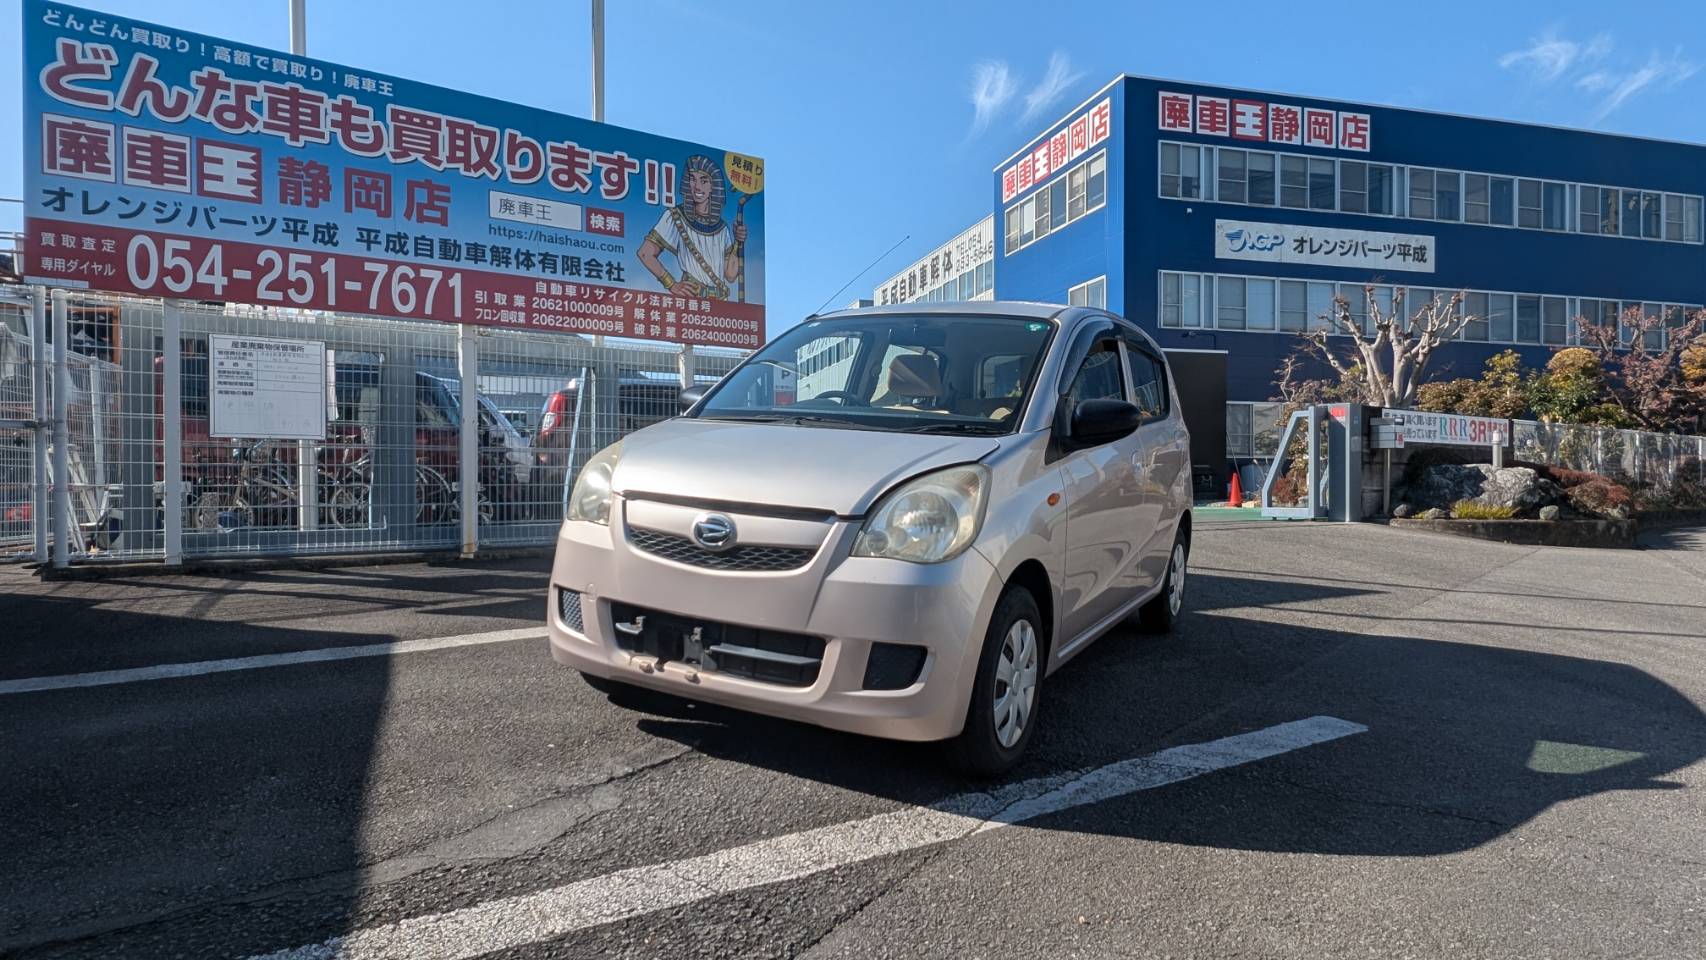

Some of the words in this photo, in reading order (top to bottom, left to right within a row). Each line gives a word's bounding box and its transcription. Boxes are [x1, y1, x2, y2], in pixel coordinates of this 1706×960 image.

[1160, 93, 1369, 150] 廃車王静岡店
[498, 198, 552, 221] 廃車王
[590, 213, 620, 232] 検索
[40, 232, 116, 253] 買取査定
[42, 187, 340, 248] オレンジパーツ平成
[356, 226, 625, 283] 平成自動車解体有限会社
[489, 224, 625, 254] https://haishaou.com
[1293, 236, 1427, 263] オレンジパーツ平成
[40, 257, 116, 276] 専用ダイヤル
[126, 234, 463, 319] 054-251-7671
[535, 281, 712, 312] 自動車リサイクル法許可番号
